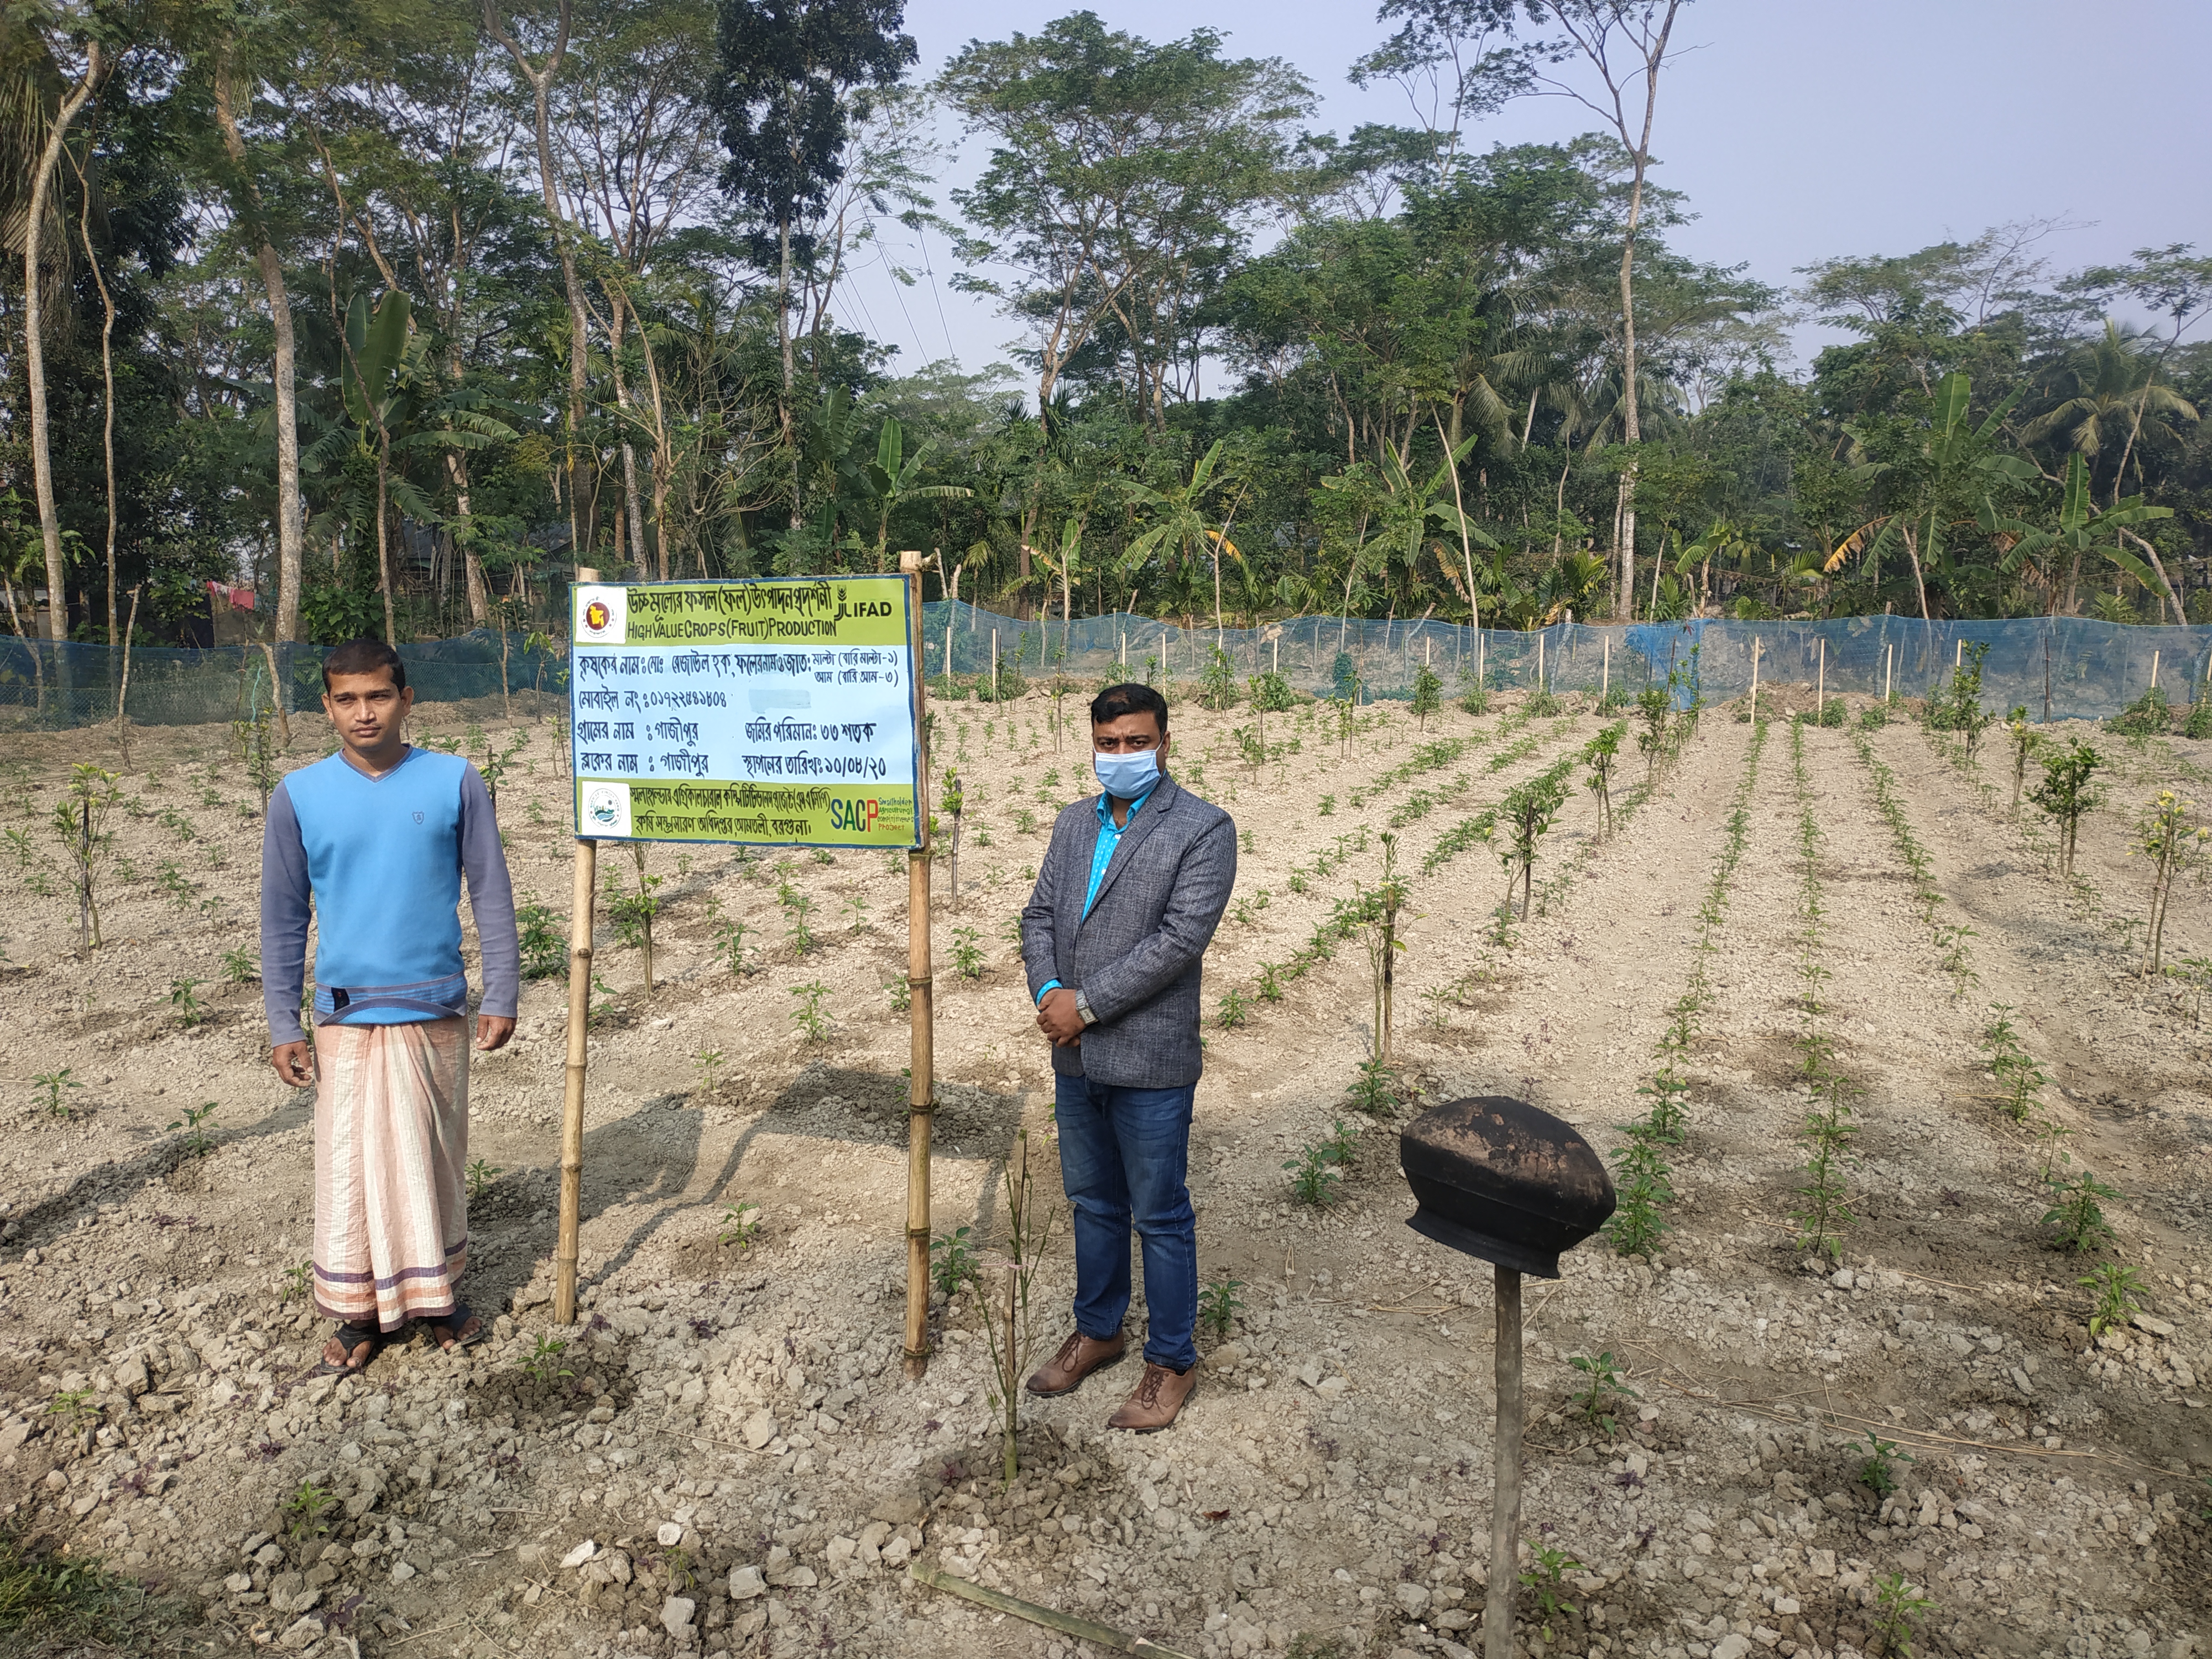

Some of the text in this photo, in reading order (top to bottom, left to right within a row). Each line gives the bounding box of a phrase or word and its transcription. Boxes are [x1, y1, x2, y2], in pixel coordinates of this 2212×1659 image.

[684, 591, 718, 612] ফসল
[854, 602, 892, 617] IFAD
[578, 656, 617, 682] কৃষকের
[671, 649, 710, 676] রেজাউল
[579, 684, 619, 712] মোবাইল
[577, 719, 609, 745] গ্রামের
[613, 722, 634, 740] নাম
[745, 716, 771, 743] জমির
[841, 722, 877, 743] শতক
[580, 753, 612, 771] ব্লকের
[617, 754, 638, 773] নাম
[634, 810, 656, 835] কৃষি
[831, 799, 878, 832] SACP
